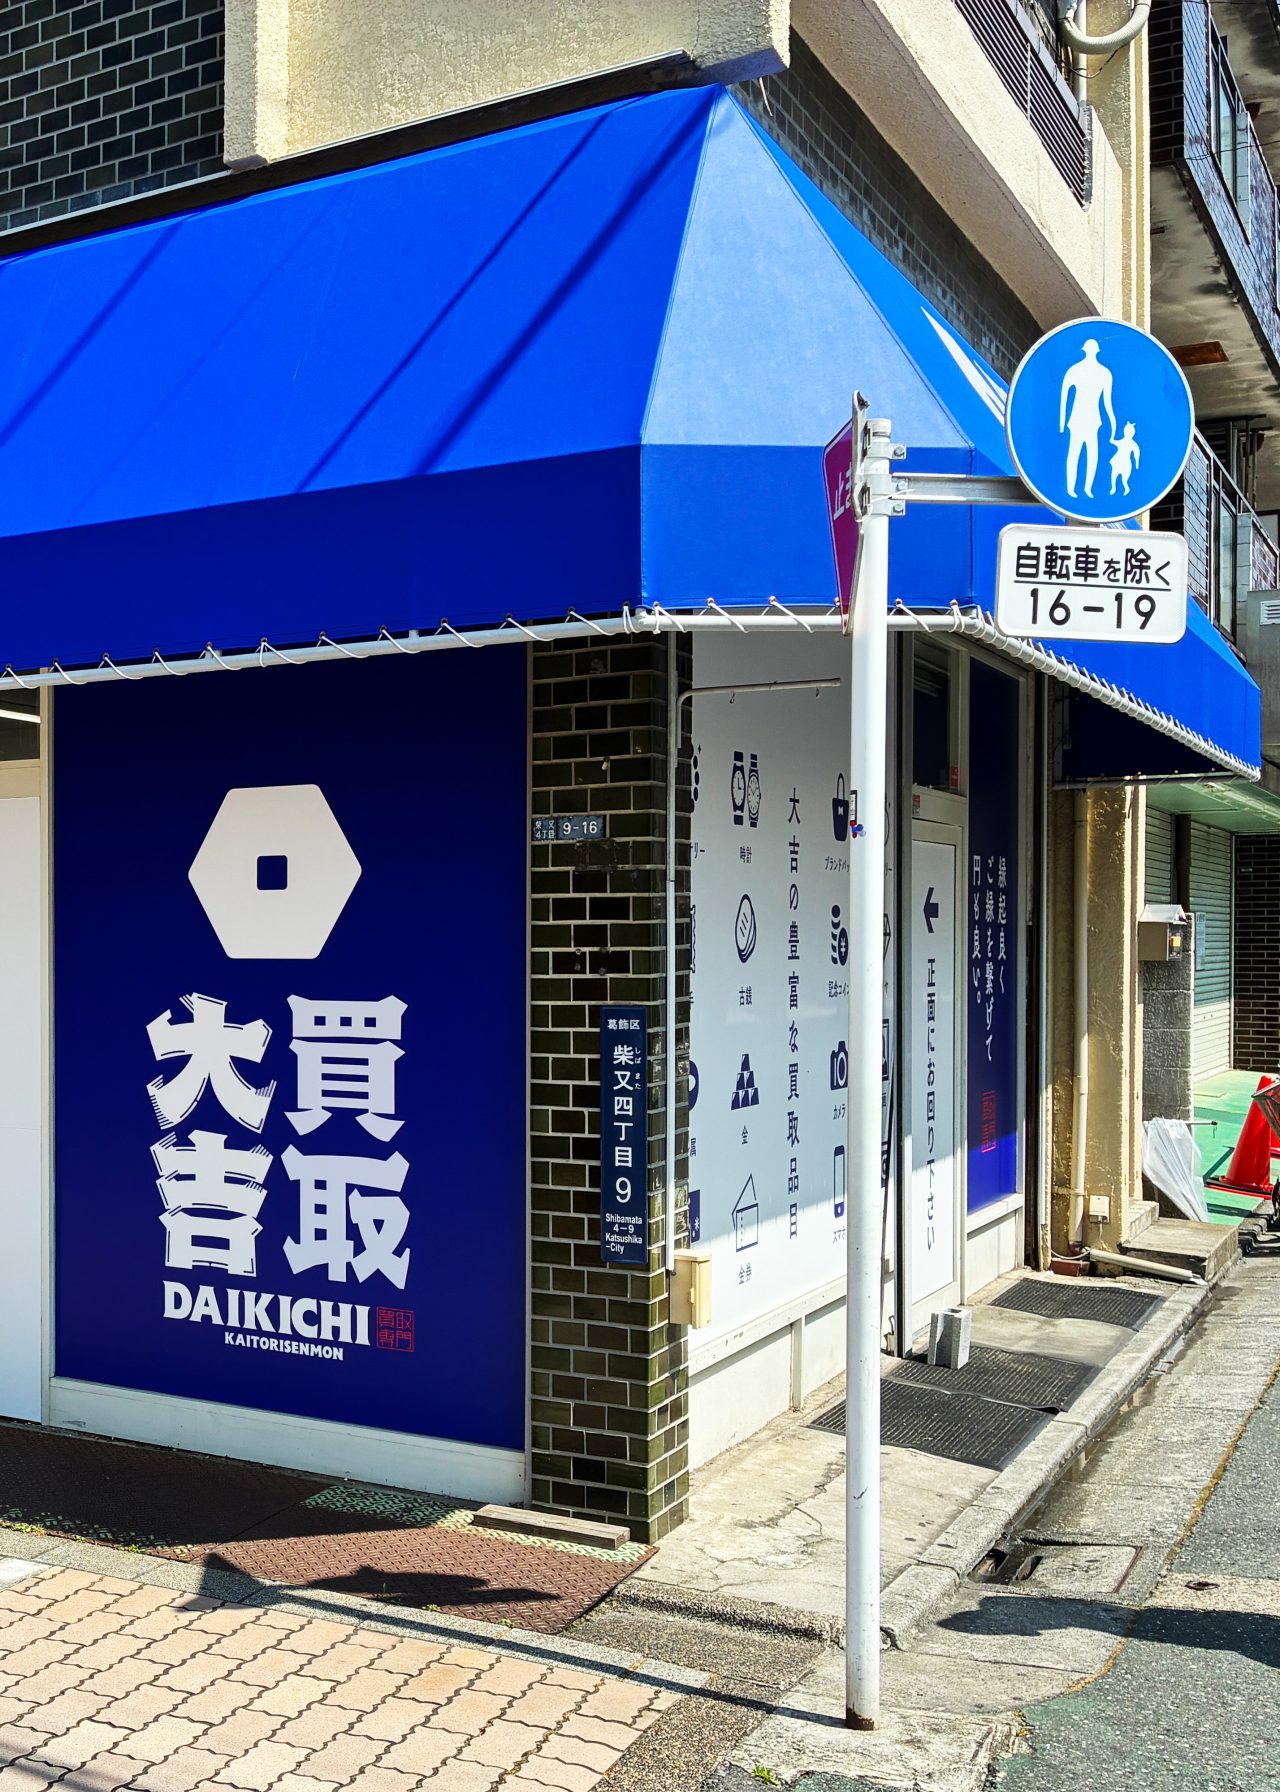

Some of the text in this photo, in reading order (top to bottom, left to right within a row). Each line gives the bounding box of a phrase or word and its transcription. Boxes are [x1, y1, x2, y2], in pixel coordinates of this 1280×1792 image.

[1014, 542, 1172, 587] 自転車を除く
[1029, 587, 1157, 631] 16-19
[535, 820, 555, 829] 柴又
[535, 830, 555, 839] 4丁目
[562, 820, 598, 835] 9-16
[997, 855, 1007, 994] 縁起良く
[607, 1018, 641, 1031] 葛飾区
[786, 787, 801, 1240] 大吉の豊富な買取品目
[925, 958, 938, 1251] 正面にお回り下さい
[145, 991, 277, 1278] 大吉
[280, 993, 411, 1290] 買取
[605, 1212, 643, 1225] Shibamata
[613, 1223, 635, 1234] 4-9
[605, 1232, 643, 1245] Katsushika
[605, 1243, 625, 1255] -City
[161, 1279, 372, 1347] DAIKICHI
[224, 1331, 344, 1361] KAITORISENMON
